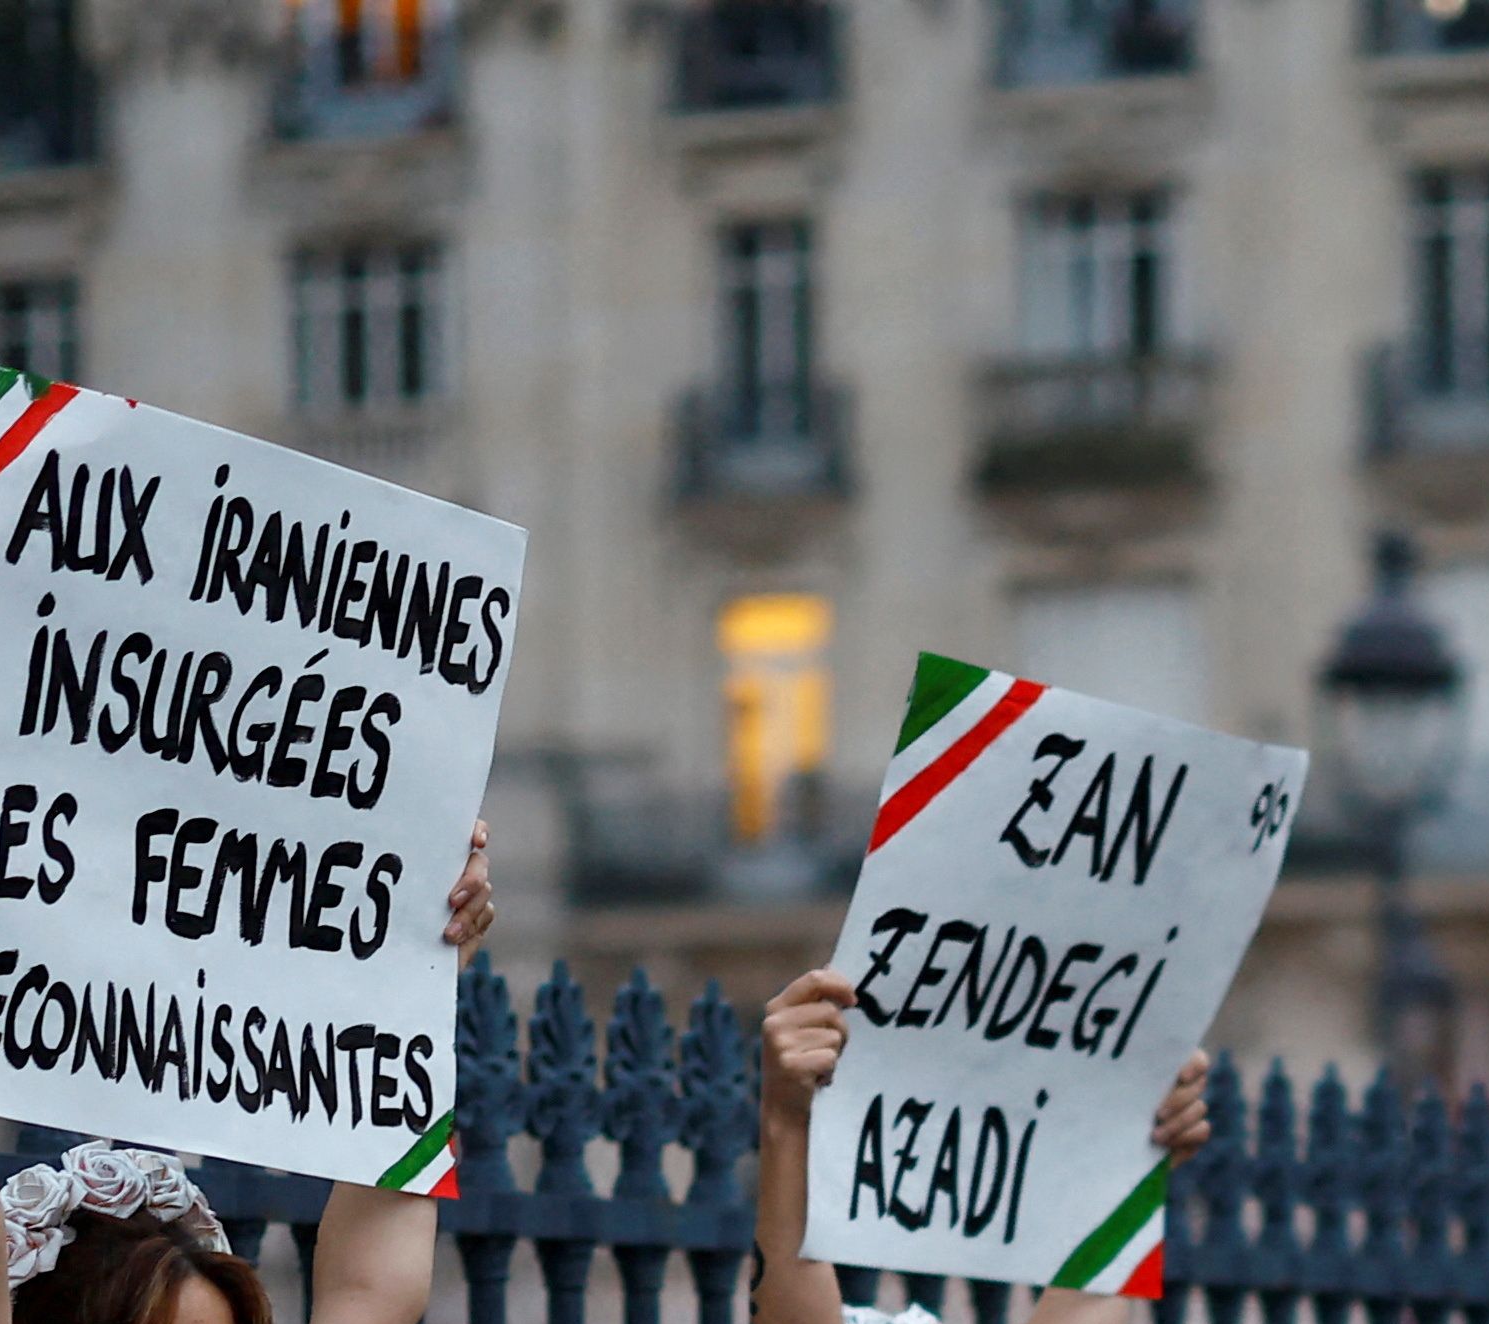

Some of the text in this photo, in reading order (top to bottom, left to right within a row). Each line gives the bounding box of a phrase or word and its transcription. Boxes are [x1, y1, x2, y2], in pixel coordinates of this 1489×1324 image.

[6, 447, 161, 585] AUX
[132, 808, 403, 960] FEMMES
[999, 732, 1188, 885] ZAN
